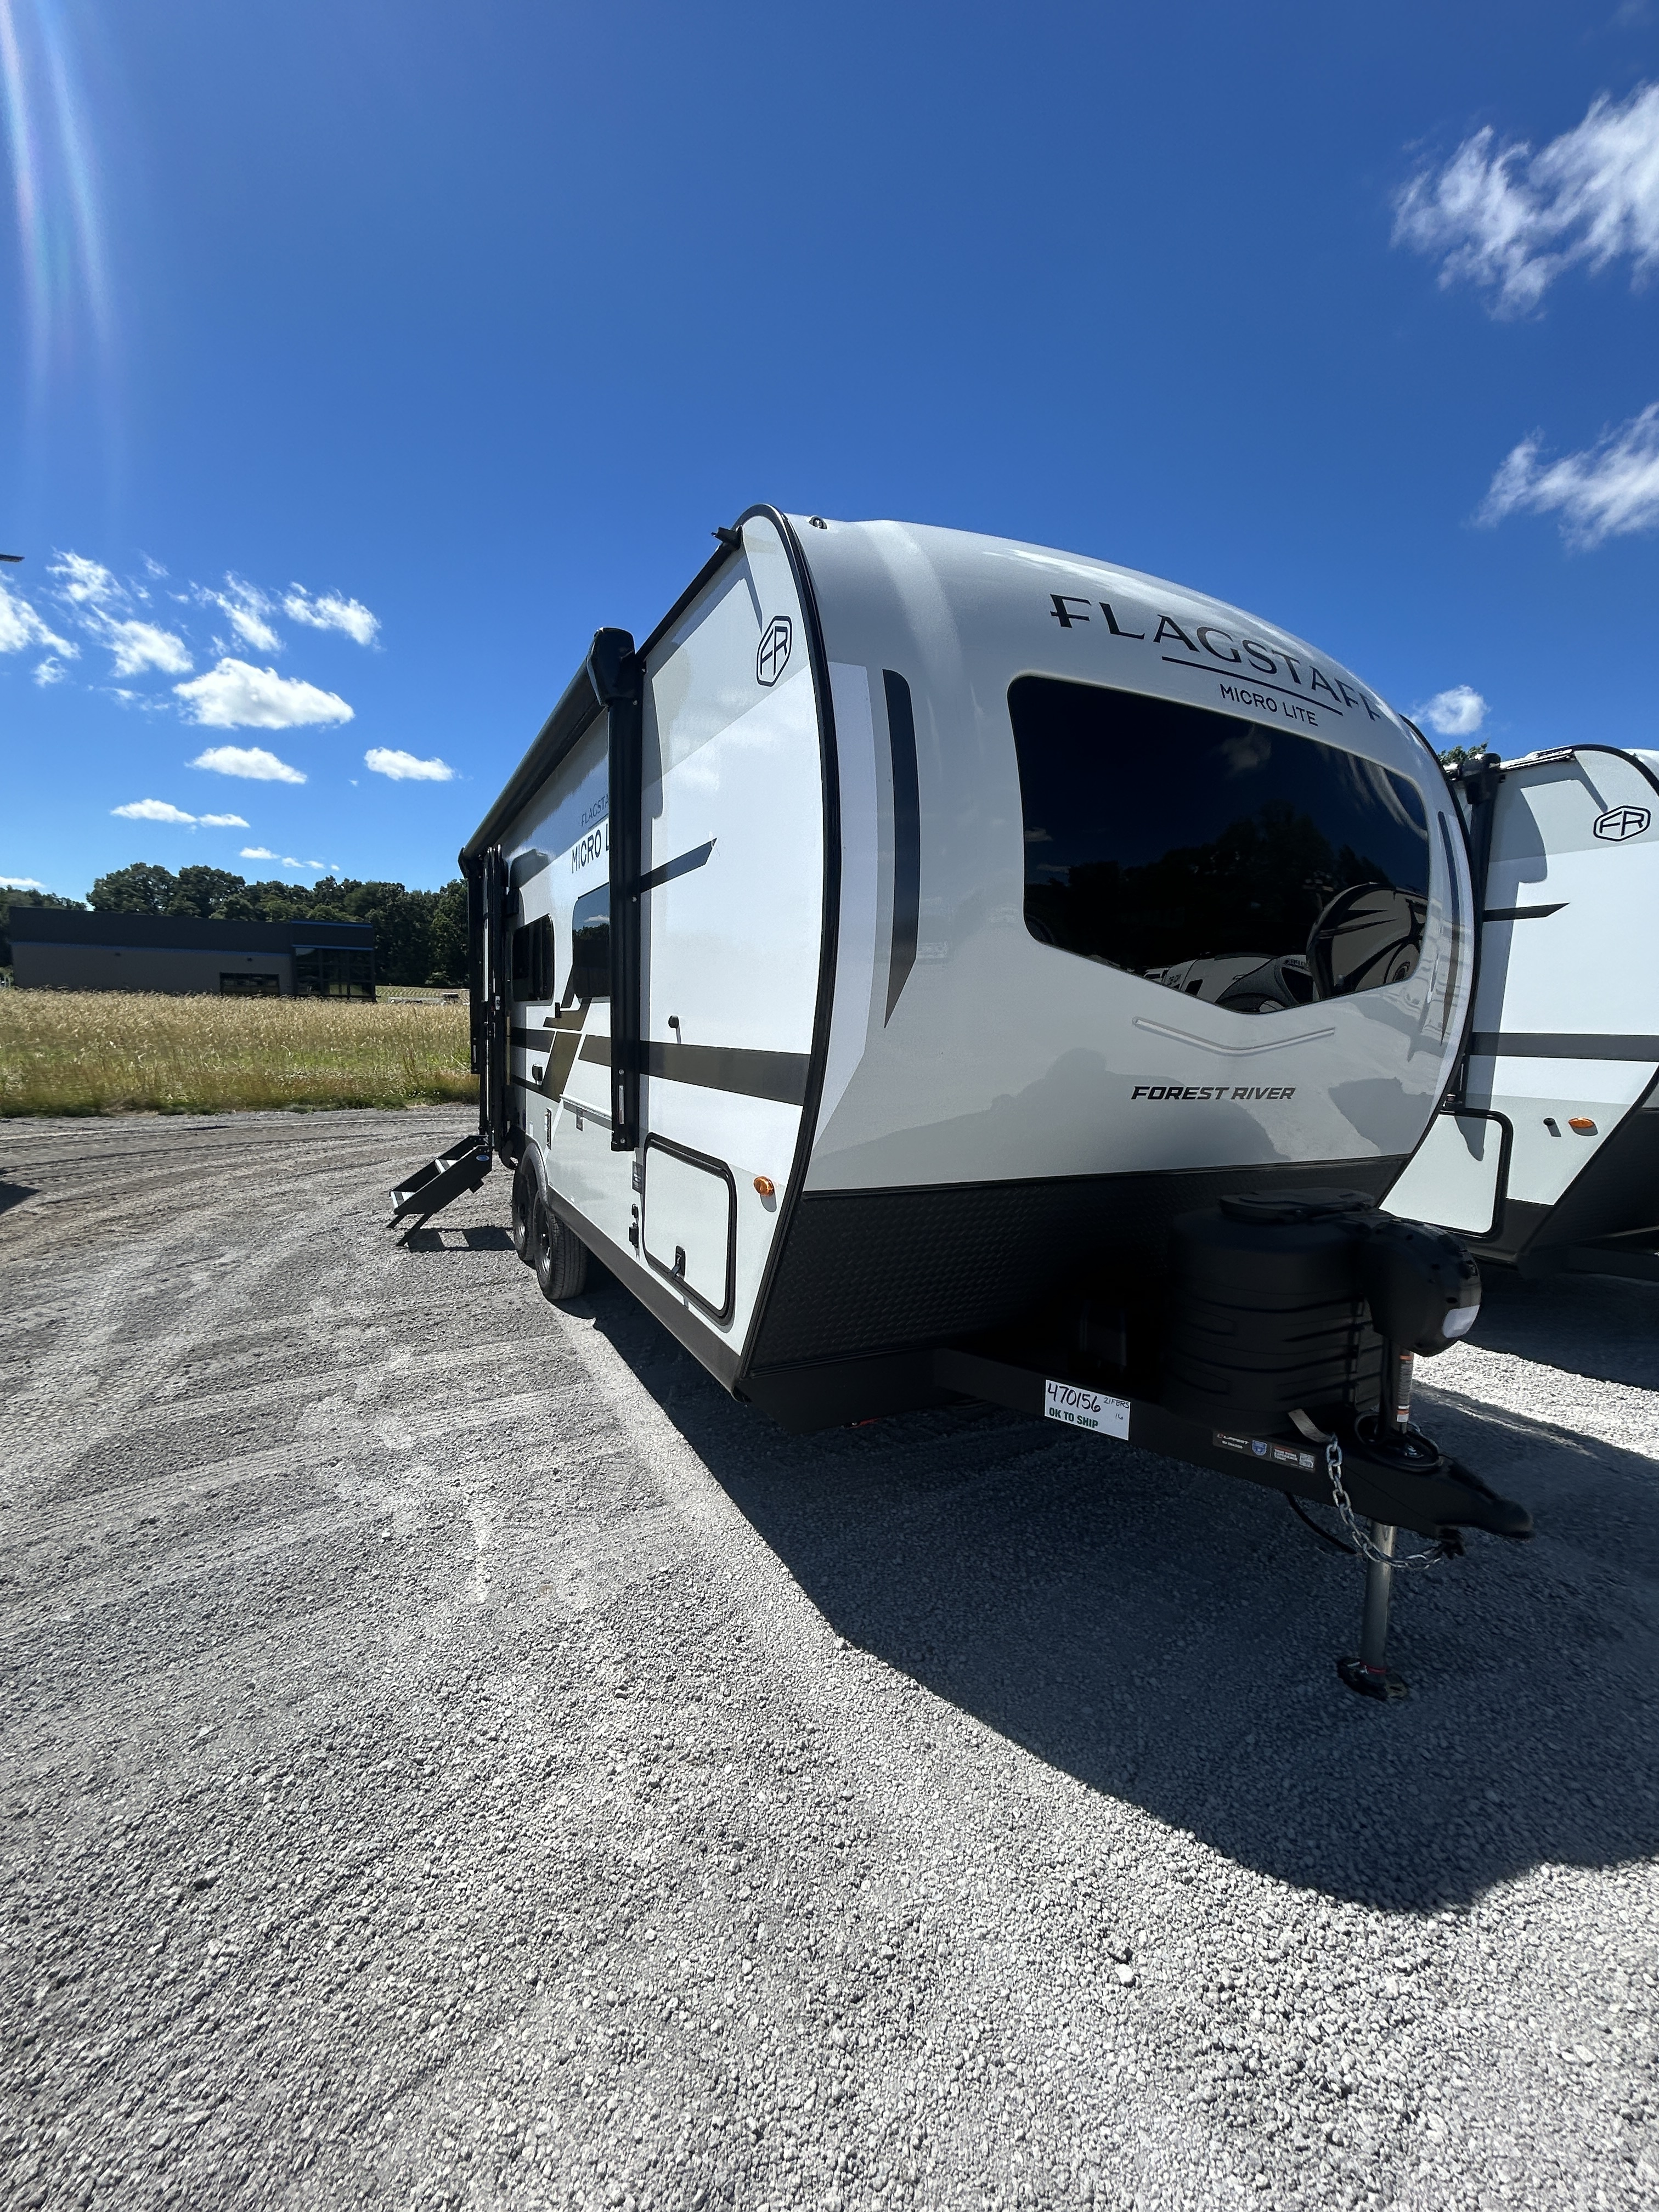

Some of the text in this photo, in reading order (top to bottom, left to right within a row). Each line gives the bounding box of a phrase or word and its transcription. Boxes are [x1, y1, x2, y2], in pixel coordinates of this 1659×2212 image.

[1049, 594, 1381, 722] FLAGSTAFF
[1220, 684, 1318, 727] MICRO LITE
[580, 793, 610, 827] FLAGSTA
[572, 829, 601, 874] MICRO
[1131, 1086, 1296, 1100] FOREST RIVER
[1047, 1382, 1101, 1413] 470156
[1049, 1407, 1098, 1429] OK TO SHIP
